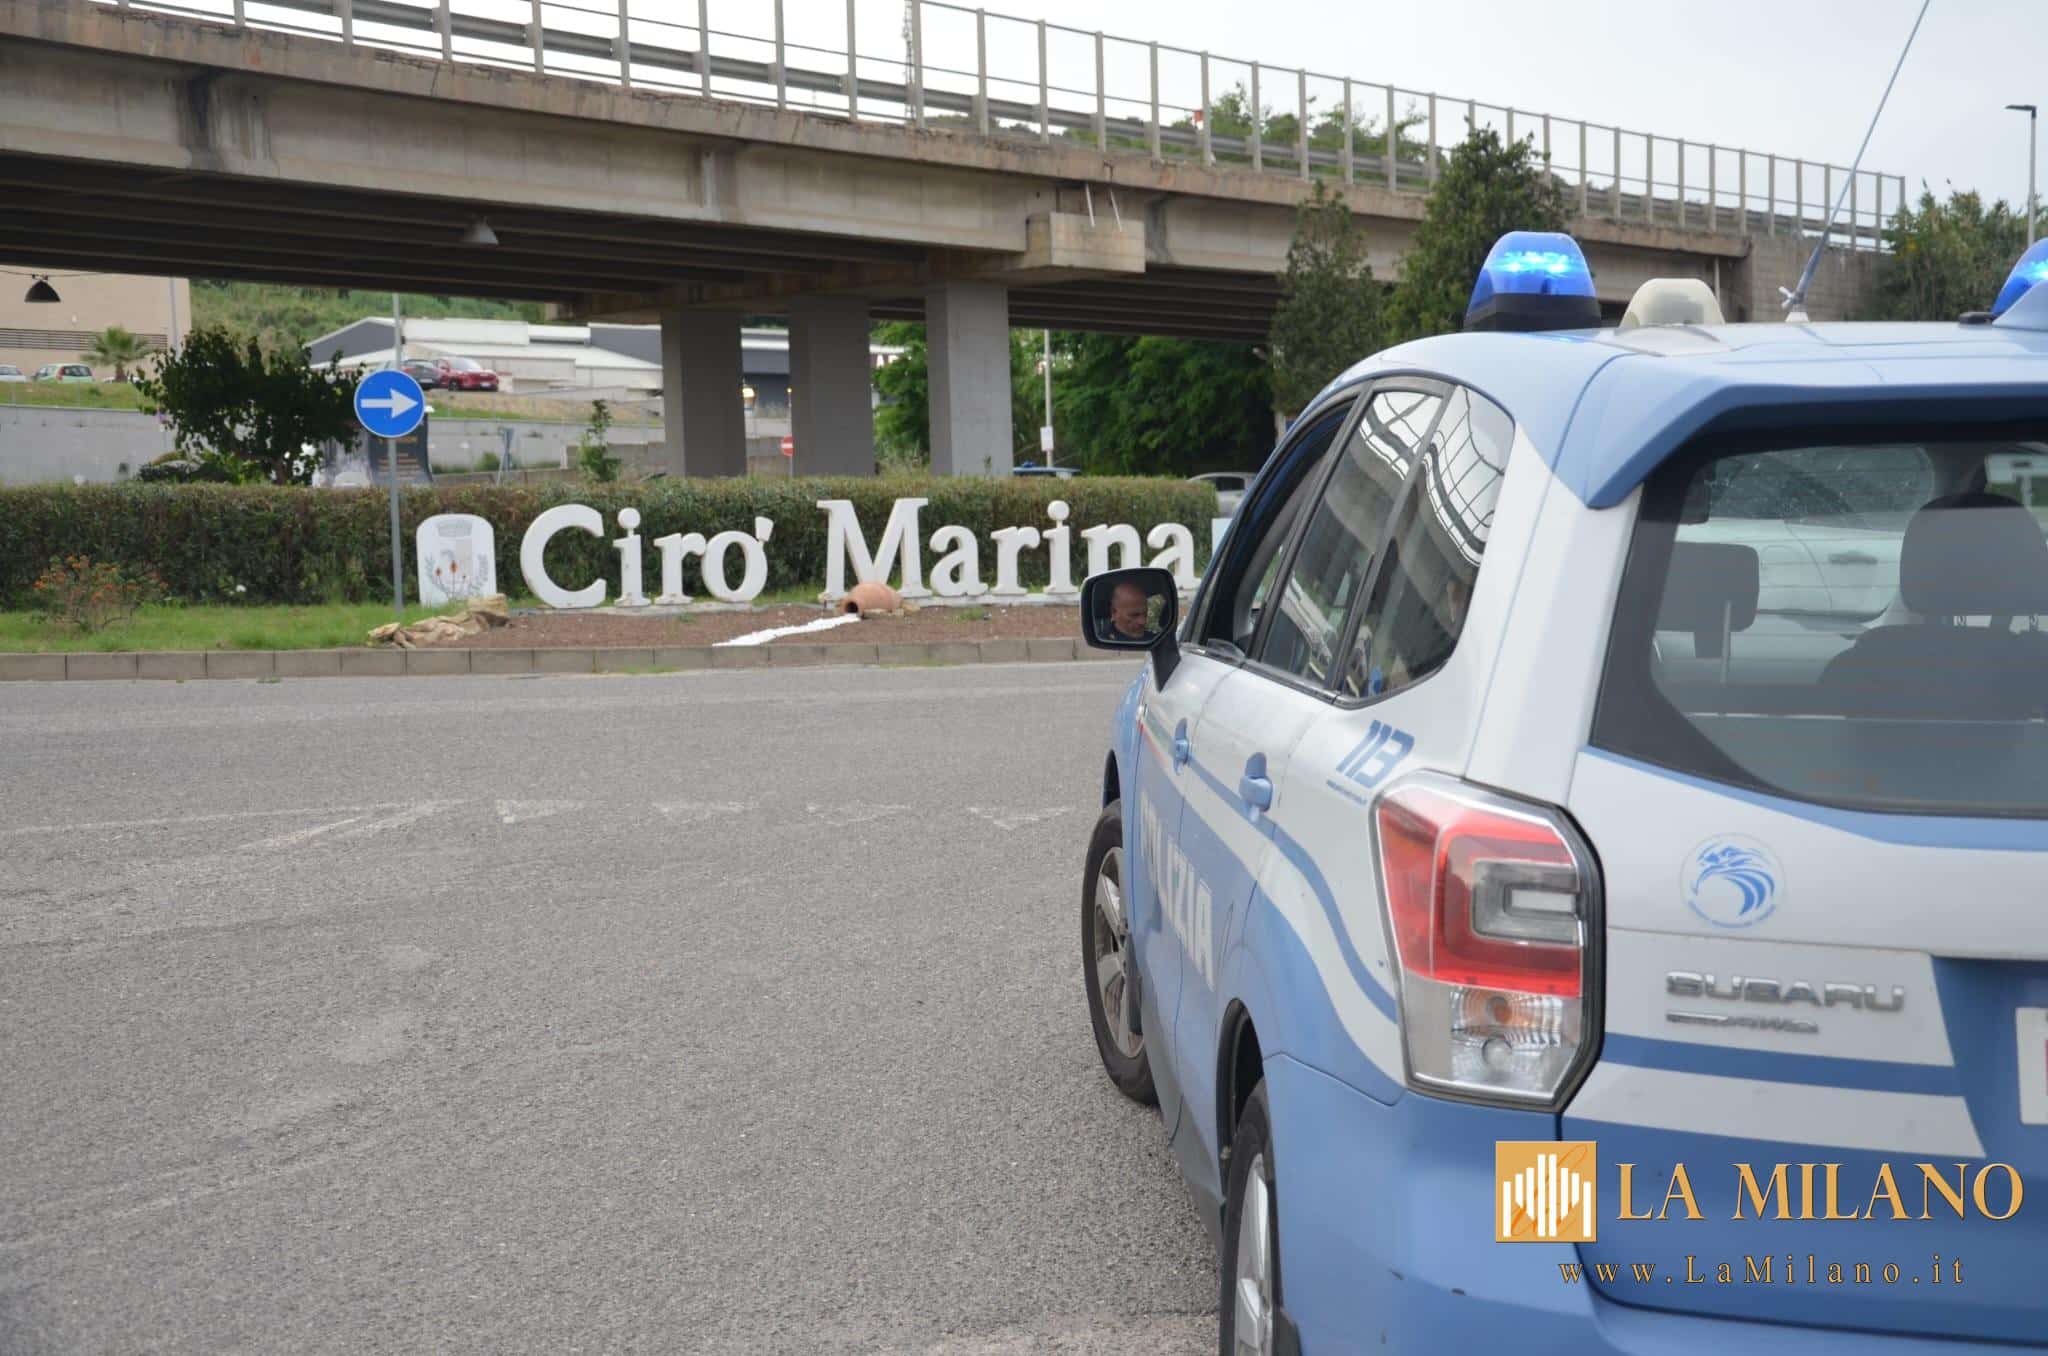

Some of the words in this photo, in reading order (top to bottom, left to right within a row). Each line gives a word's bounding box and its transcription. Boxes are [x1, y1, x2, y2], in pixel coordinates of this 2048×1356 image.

[816, 497, 1201, 600] Marina
[1335, 719, 1415, 789] 113
[1666, 971, 1904, 1012] SUBARU
